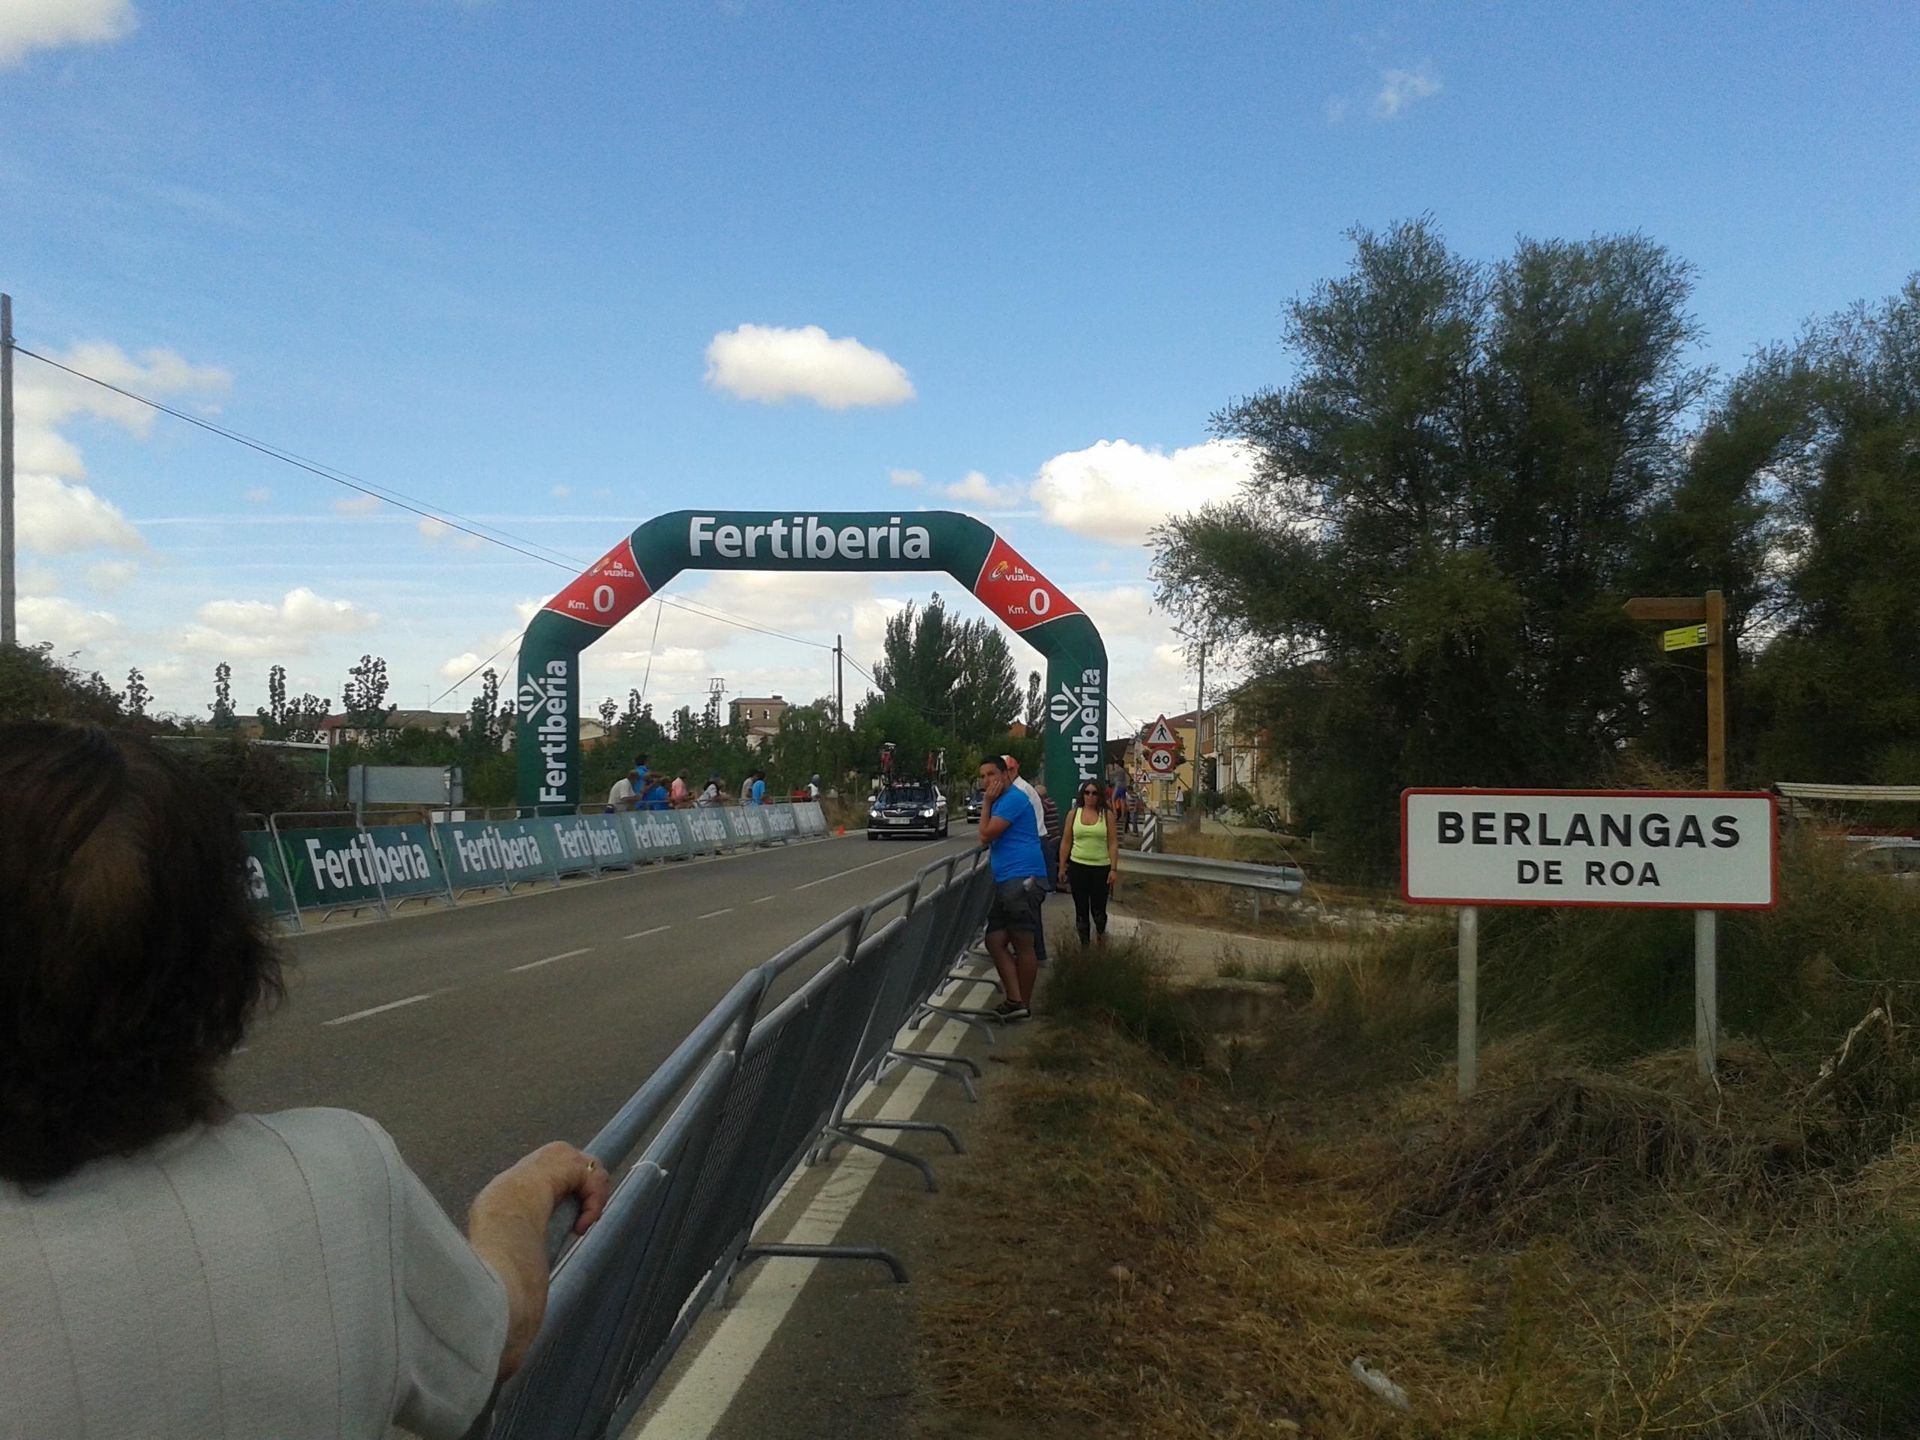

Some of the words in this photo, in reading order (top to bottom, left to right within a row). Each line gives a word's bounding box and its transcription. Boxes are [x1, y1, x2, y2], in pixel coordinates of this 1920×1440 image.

[690, 516, 930, 559] Fertiberia
[568, 600, 589, 610] Km.
[593, 585, 615, 612] 0
[1008, 604, 1028, 615] Km.
[1029, 588, 1050, 615] 0
[538, 660, 567, 802] Fertiberia
[1071, 668, 1101, 808] rtiberia
[1153, 755, 1170, 764] 40
[453, 825, 543, 873] Fertiberia
[554, 819, 623, 858] Fertiberia
[1437, 811, 1740, 848] BERLANGAS
[305, 832, 431, 890] Fertiberia
[1517, 860, 1563, 885] DE
[1585, 861, 1660, 886] ROA
